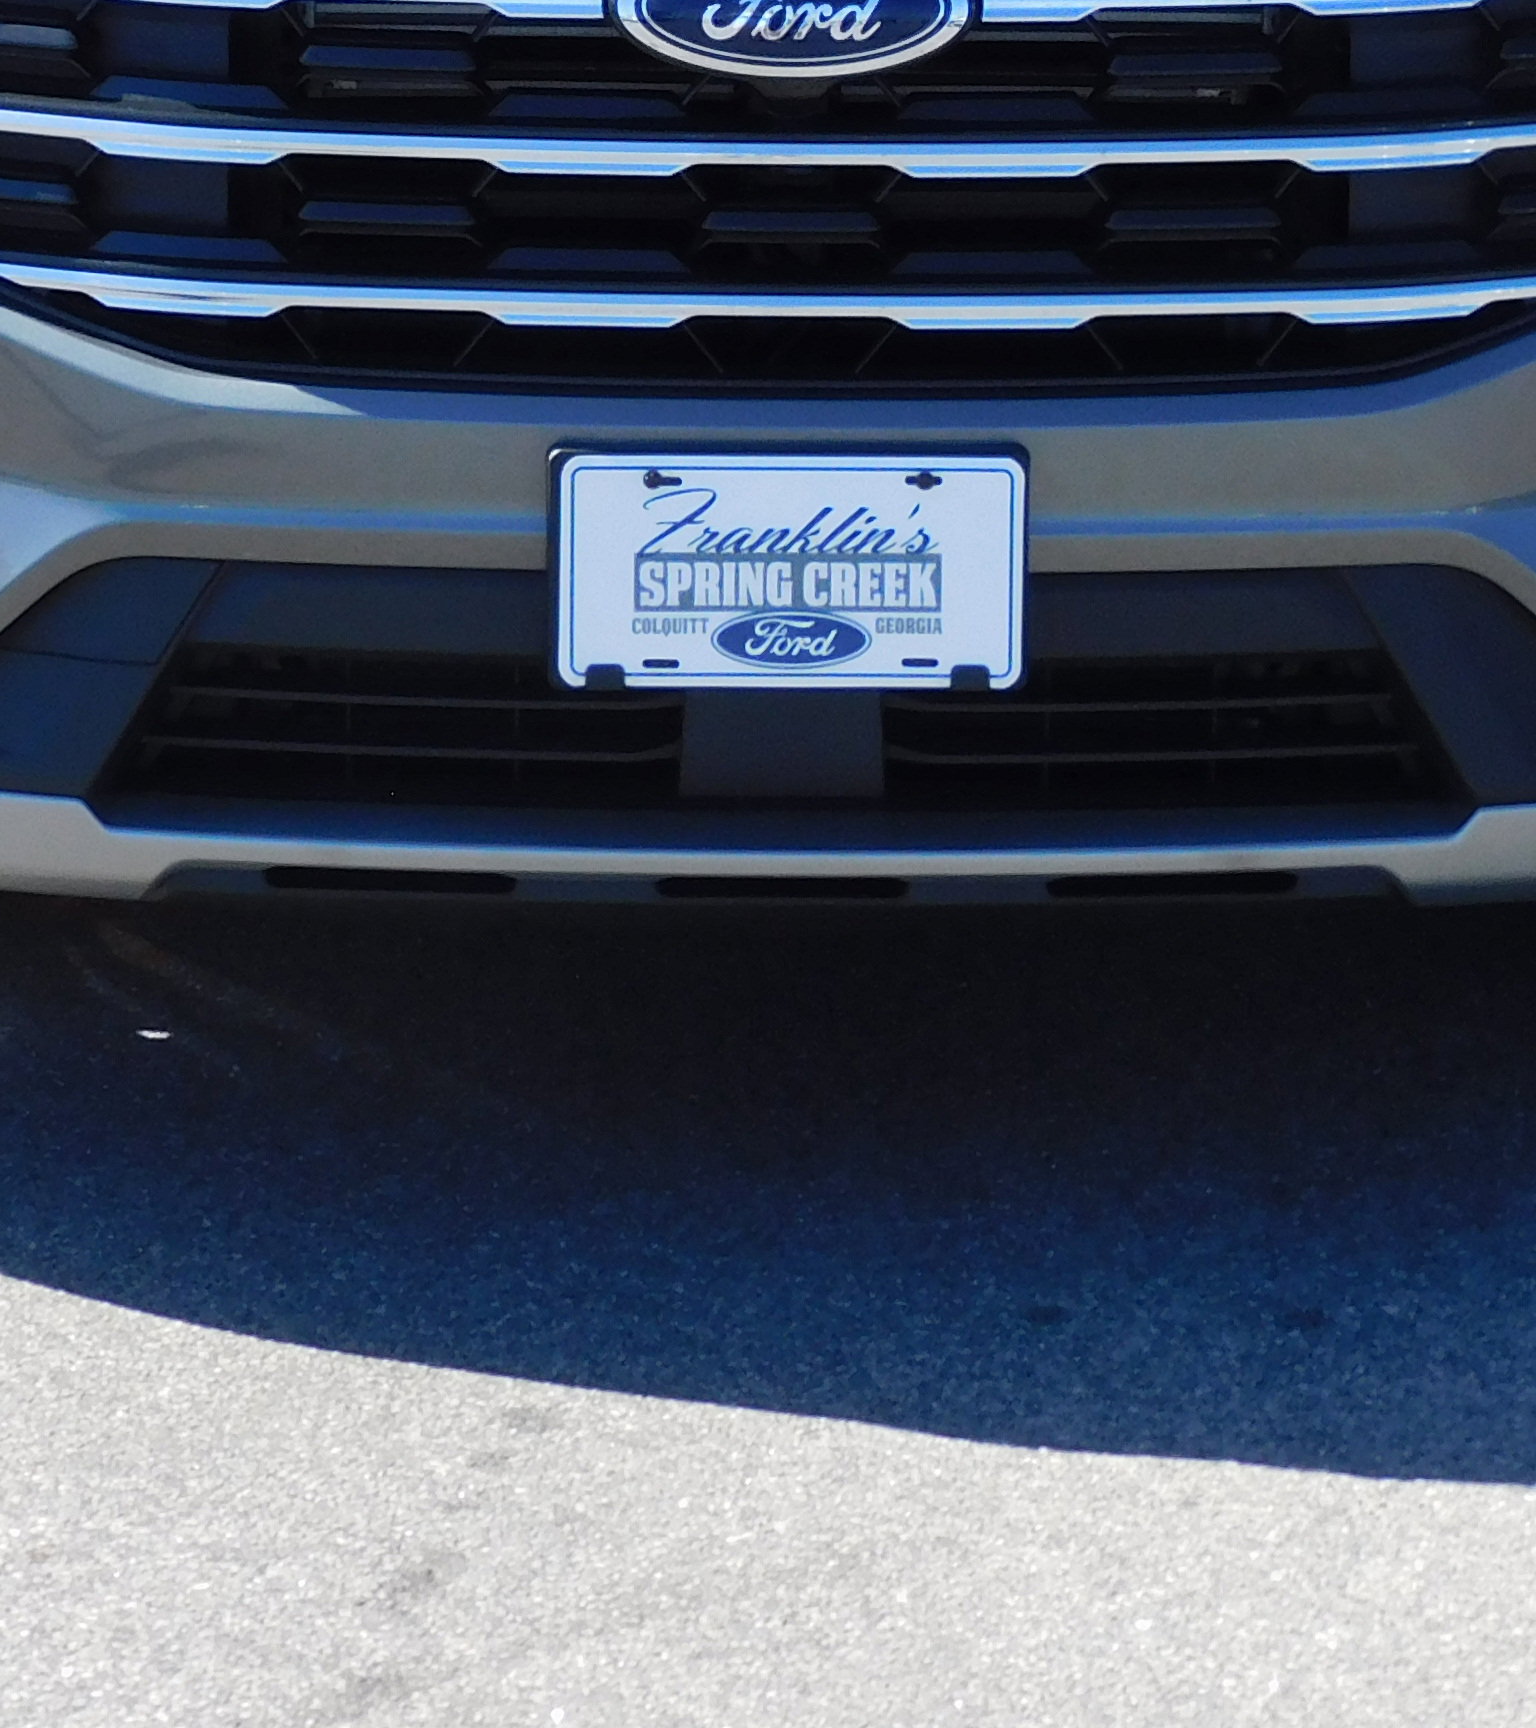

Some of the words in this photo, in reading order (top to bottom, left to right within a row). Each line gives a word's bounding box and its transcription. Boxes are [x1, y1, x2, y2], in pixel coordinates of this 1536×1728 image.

[642, 488, 937, 556] Franklin's
[640, 562, 793, 608] SPRING
[803, 561, 939, 608] CREEK
[632, 618, 709, 636] COLQUITT
[745, 619, 838, 657] Ford
[876, 618, 943, 635] GEORGIA
